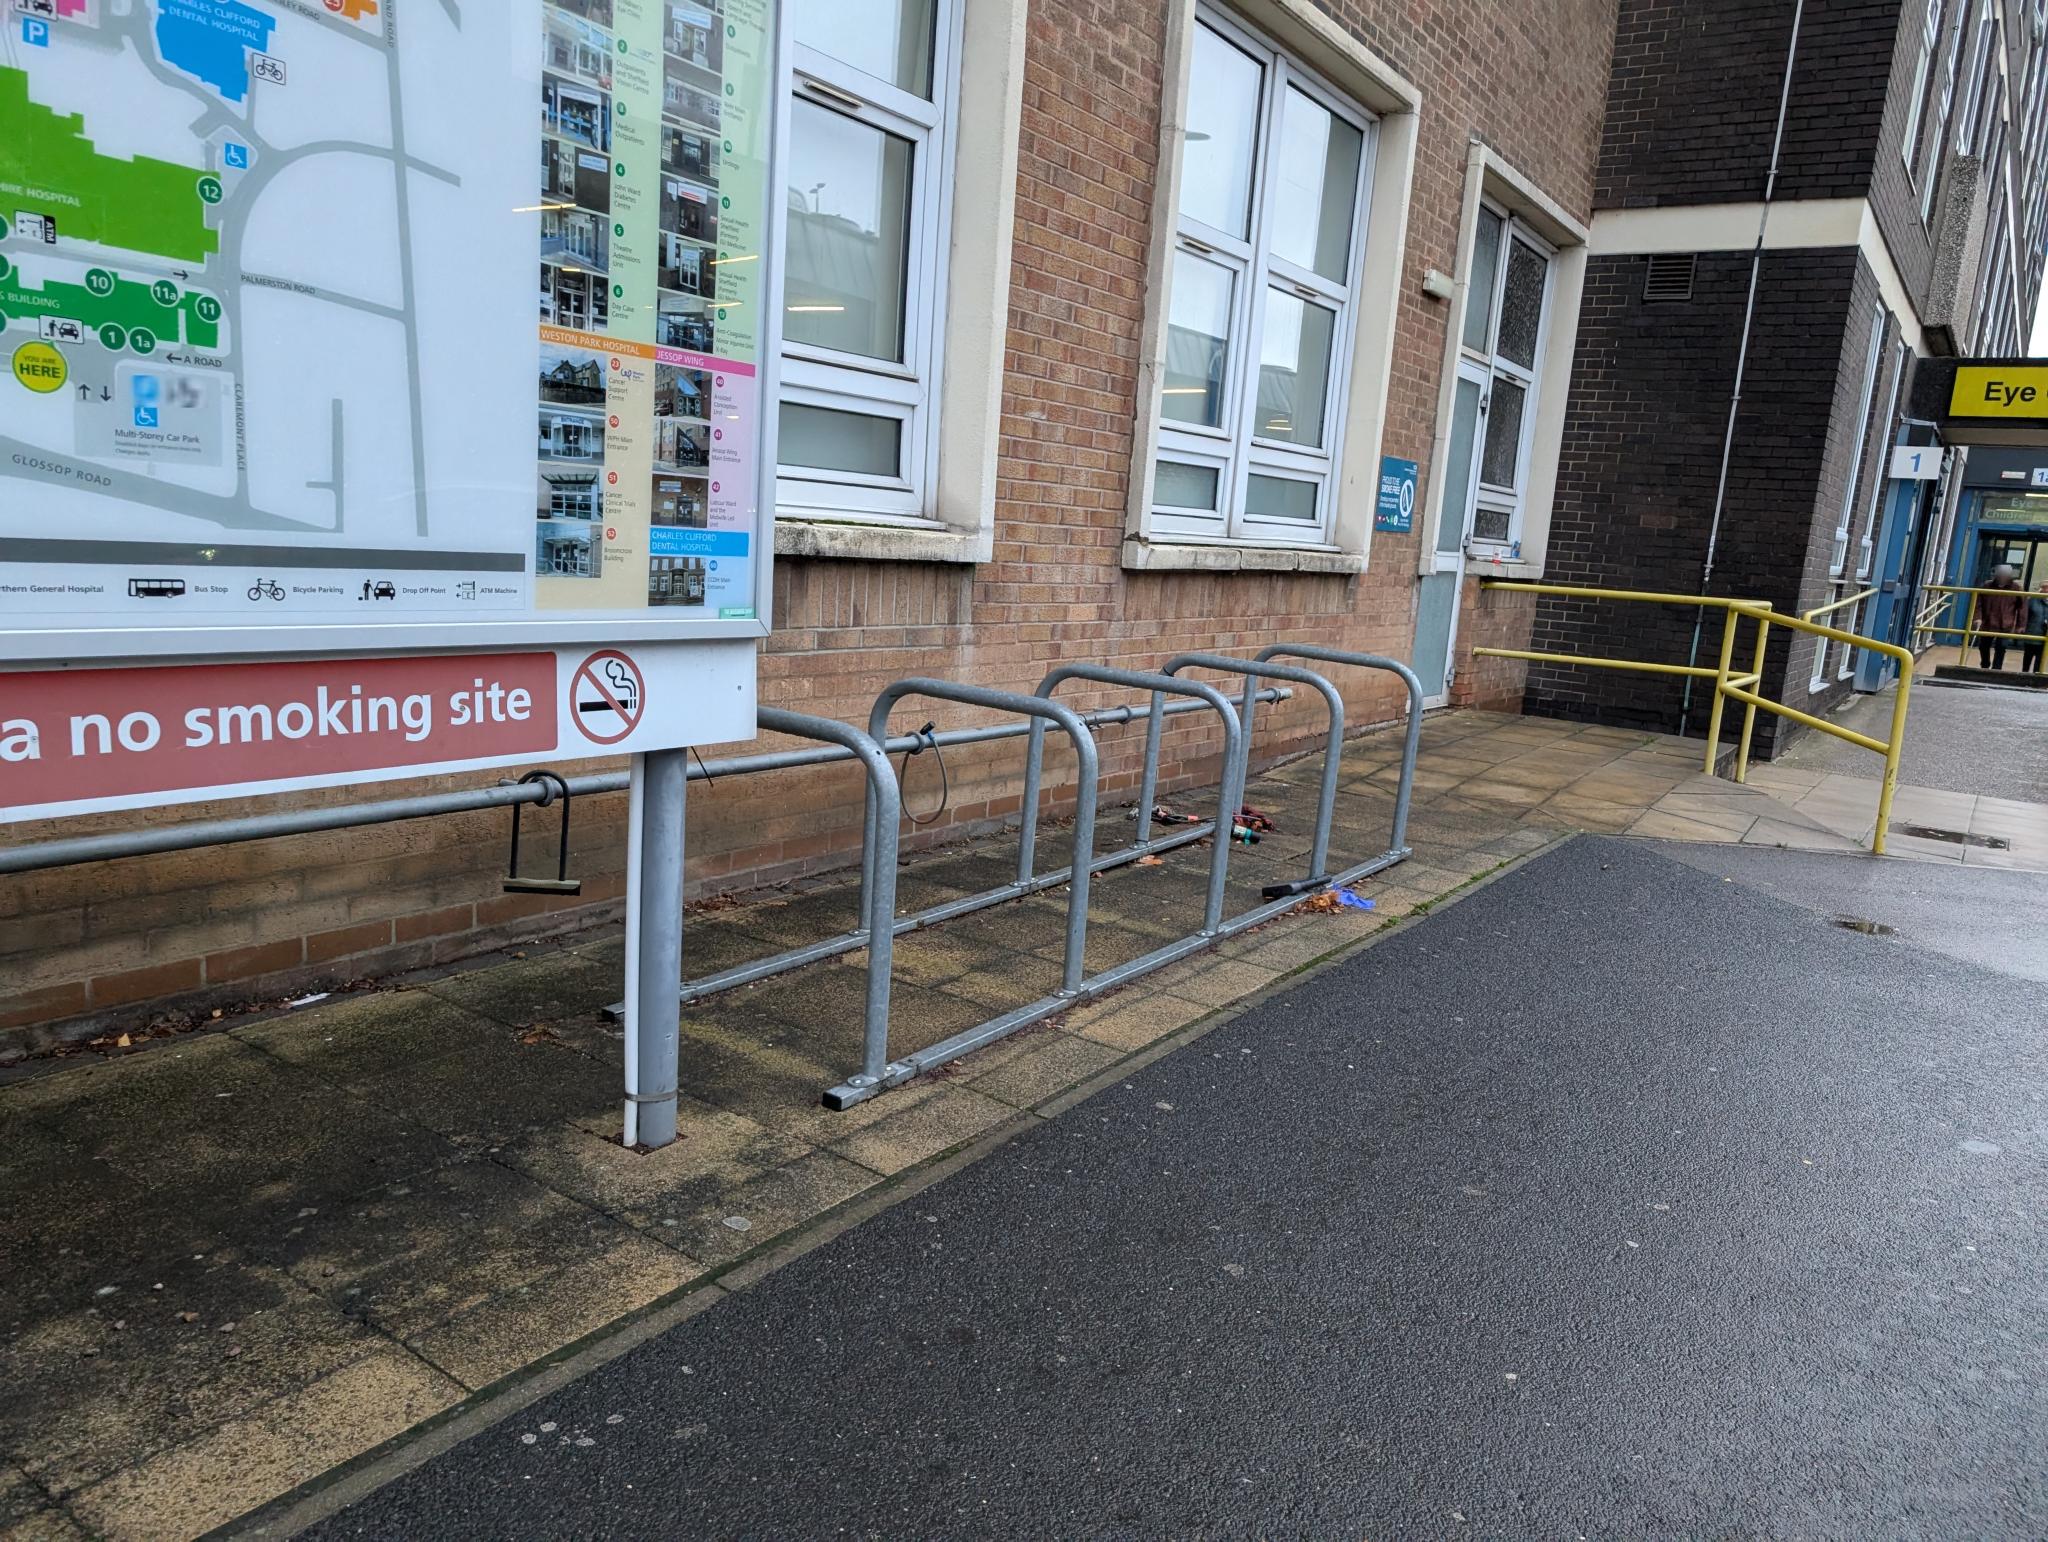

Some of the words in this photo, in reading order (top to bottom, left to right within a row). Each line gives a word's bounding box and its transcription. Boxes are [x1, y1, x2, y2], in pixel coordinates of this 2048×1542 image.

[169, 6, 207, 25] DENTAL
[212, 20, 259, 42] HOSPITAL
[215, 8, 260, 29] CLIFFORD
[27, 188, 81, 208] HOSPITAL
[203, 185, 219, 199] 12
[45, 221, 55, 241] ATM
[90, 275, 109, 289] 10
[241, 275, 292, 291] PALMERSTON
[294, 282, 316, 295] ROAD
[8, 292, 61, 309] BUILDING
[154, 285, 177, 301] 11a
[201, 302, 216, 316] 11
[108, 331, 116, 344] 1
[136, 335, 151, 348] 1a
[541, 330, 578, 344] WESTON
[580, 336, 601, 348] PARK
[603, 341, 640, 355] HOSPITAL
[194, 357, 222, 368] ROAD
[657, 351, 683, 361] JESSOP
[684, 355, 704, 366] WING
[20, 363, 61, 379] HERE
[1984, 381, 2037, 408] Eye
[235, 383, 245, 444] CLAREMONT
[115, 429, 164, 442] Multi-Storey
[167, 433, 180, 442] Car
[182, 434, 201, 443] Park
[12, 454, 72, 476] GLOSSOP
[76, 470, 112, 487] ROAD
[1910, 453, 1922, 473] 1
[652, 530, 684, 540] CHARLES
[685, 532, 717, 542] CLIFFORD
[652, 542, 679, 551] DENTAL
[681, 544, 713, 552] HOSPITAL
[30, 584, 65, 593] General
[68, 584, 104, 595] Hospital
[194, 585, 208, 593] Bus
[211, 585, 229, 595] Stop
[293, 586, 317, 595] Bicycle
[318, 586, 344, 595] Parking
[402, 587, 417, 595] Drop
[494, 587, 518, 595] Machine
[0, 719, 42, 762] a
[70, 711, 162, 757] no
[184, 685, 432, 748] smoking
[450, 678, 532, 726] site
